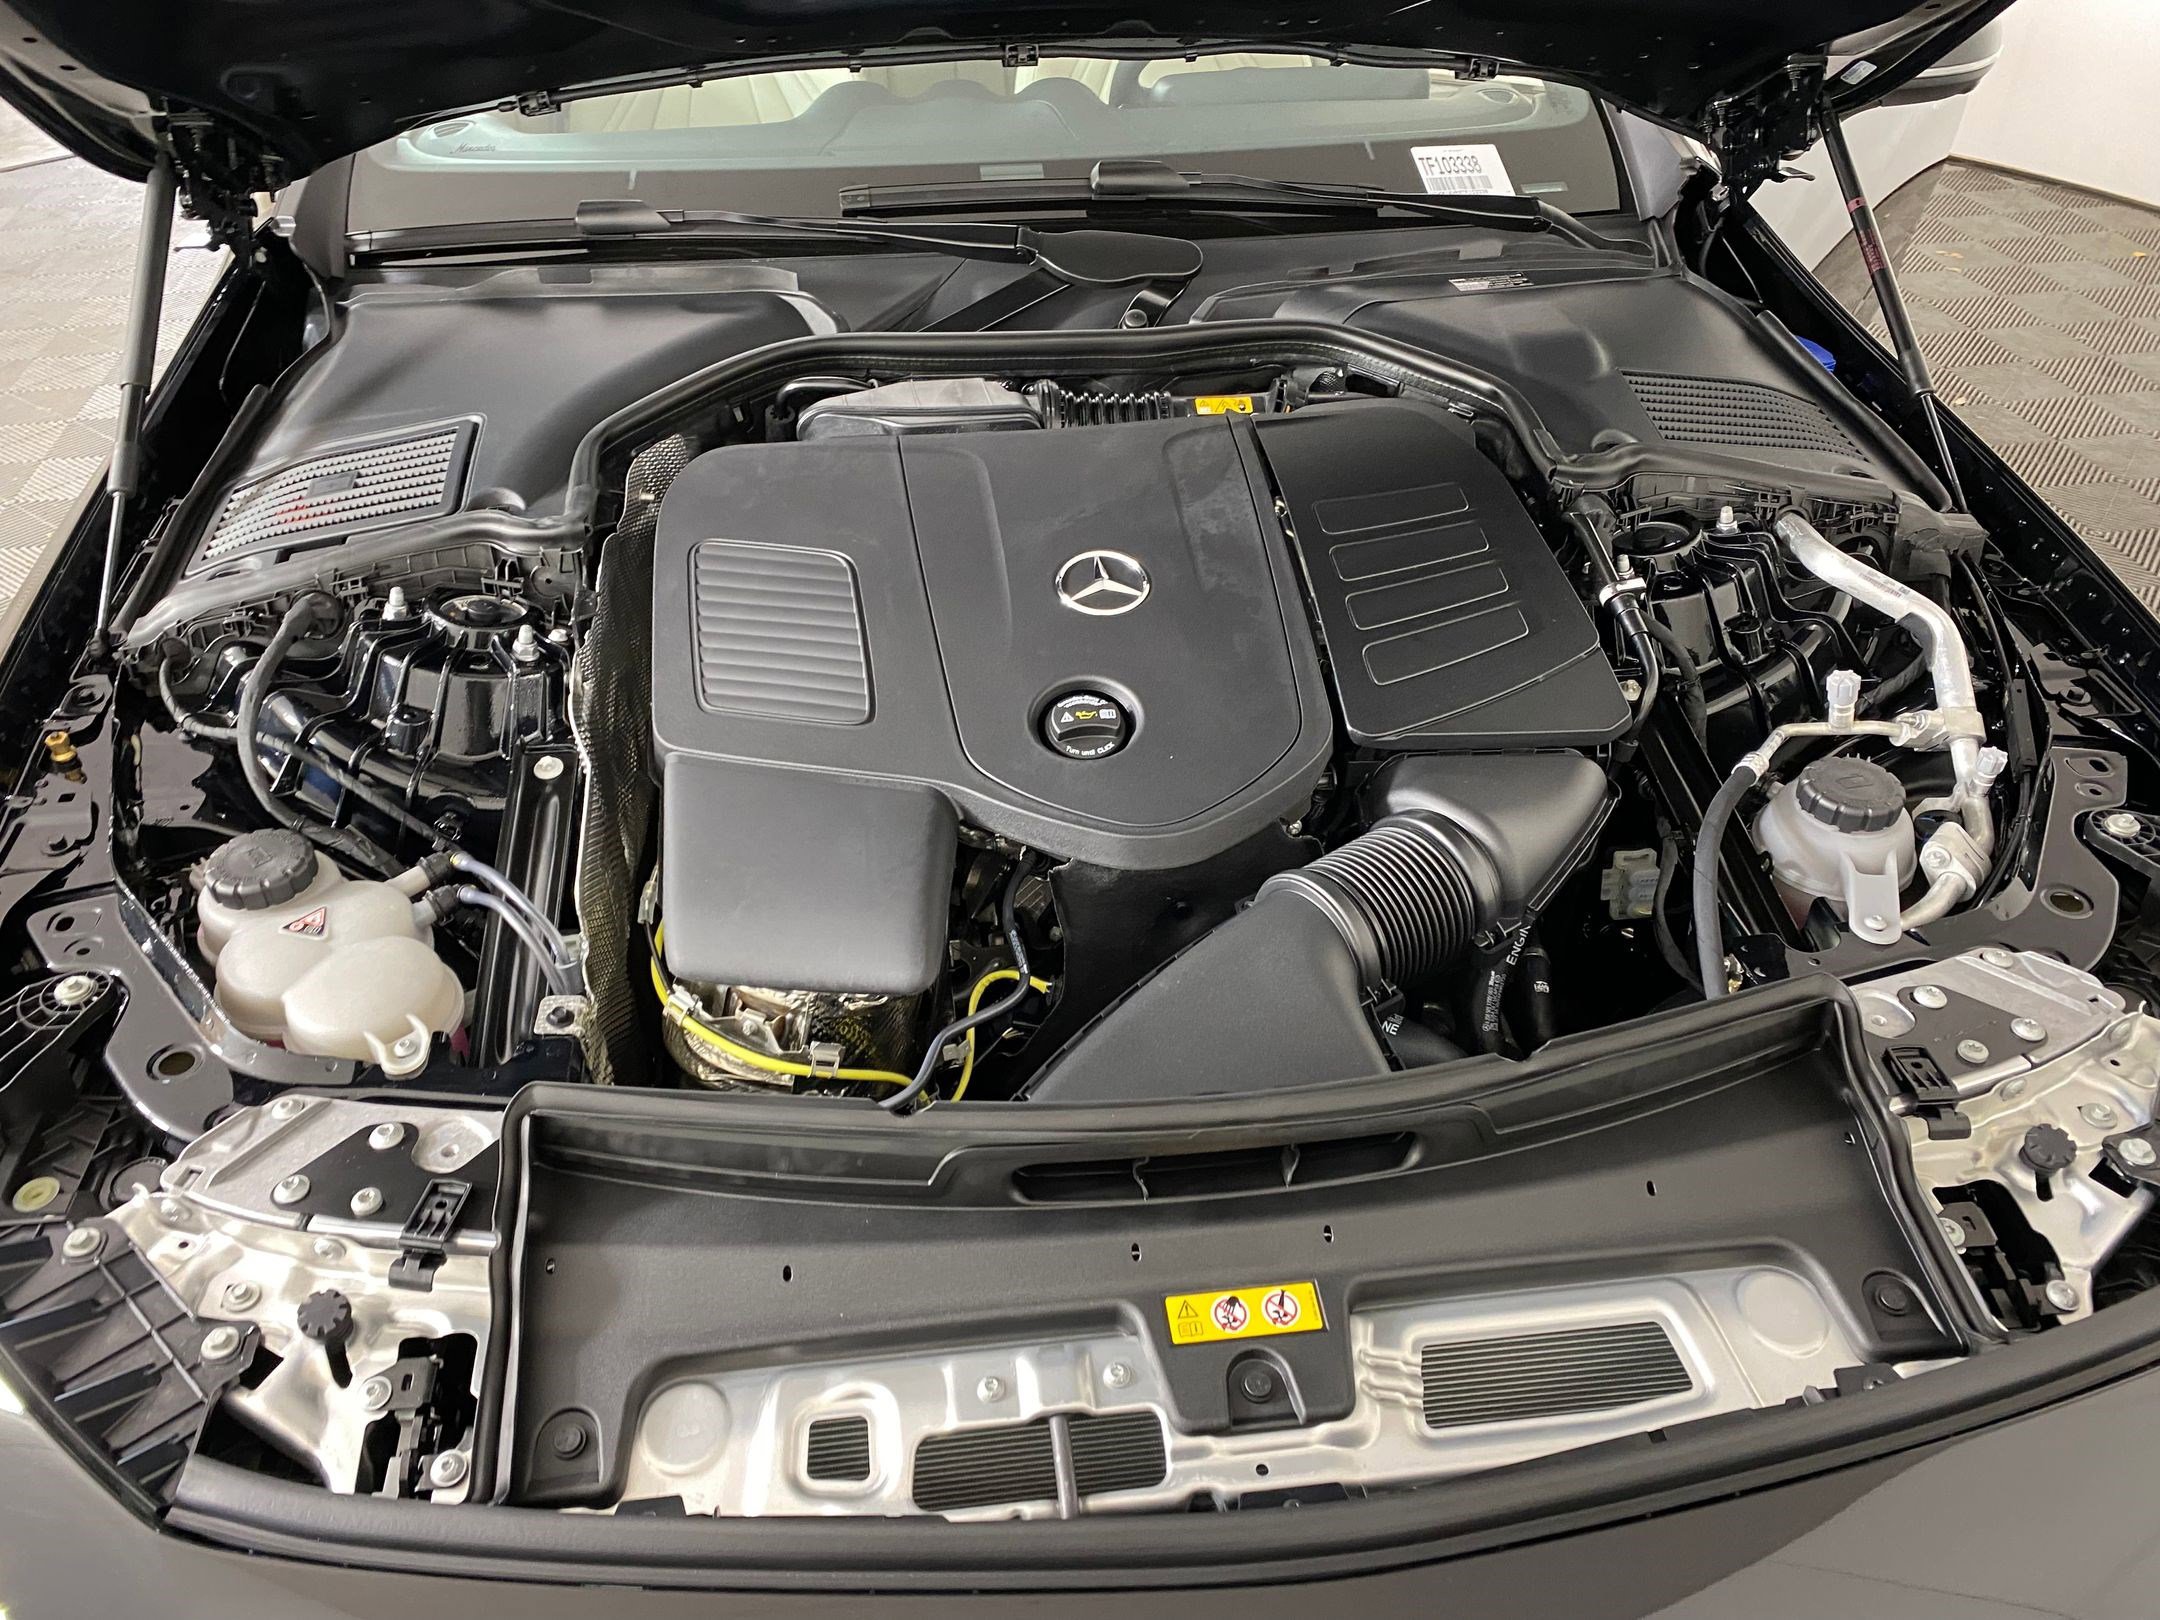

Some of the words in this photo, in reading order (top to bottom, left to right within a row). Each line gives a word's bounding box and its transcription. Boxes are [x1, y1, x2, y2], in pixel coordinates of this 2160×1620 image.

[1418, 155, 1482, 176] TF103338
[1066, 745, 1080, 755] Turn
[1097, 741, 1115, 754] CLICK
